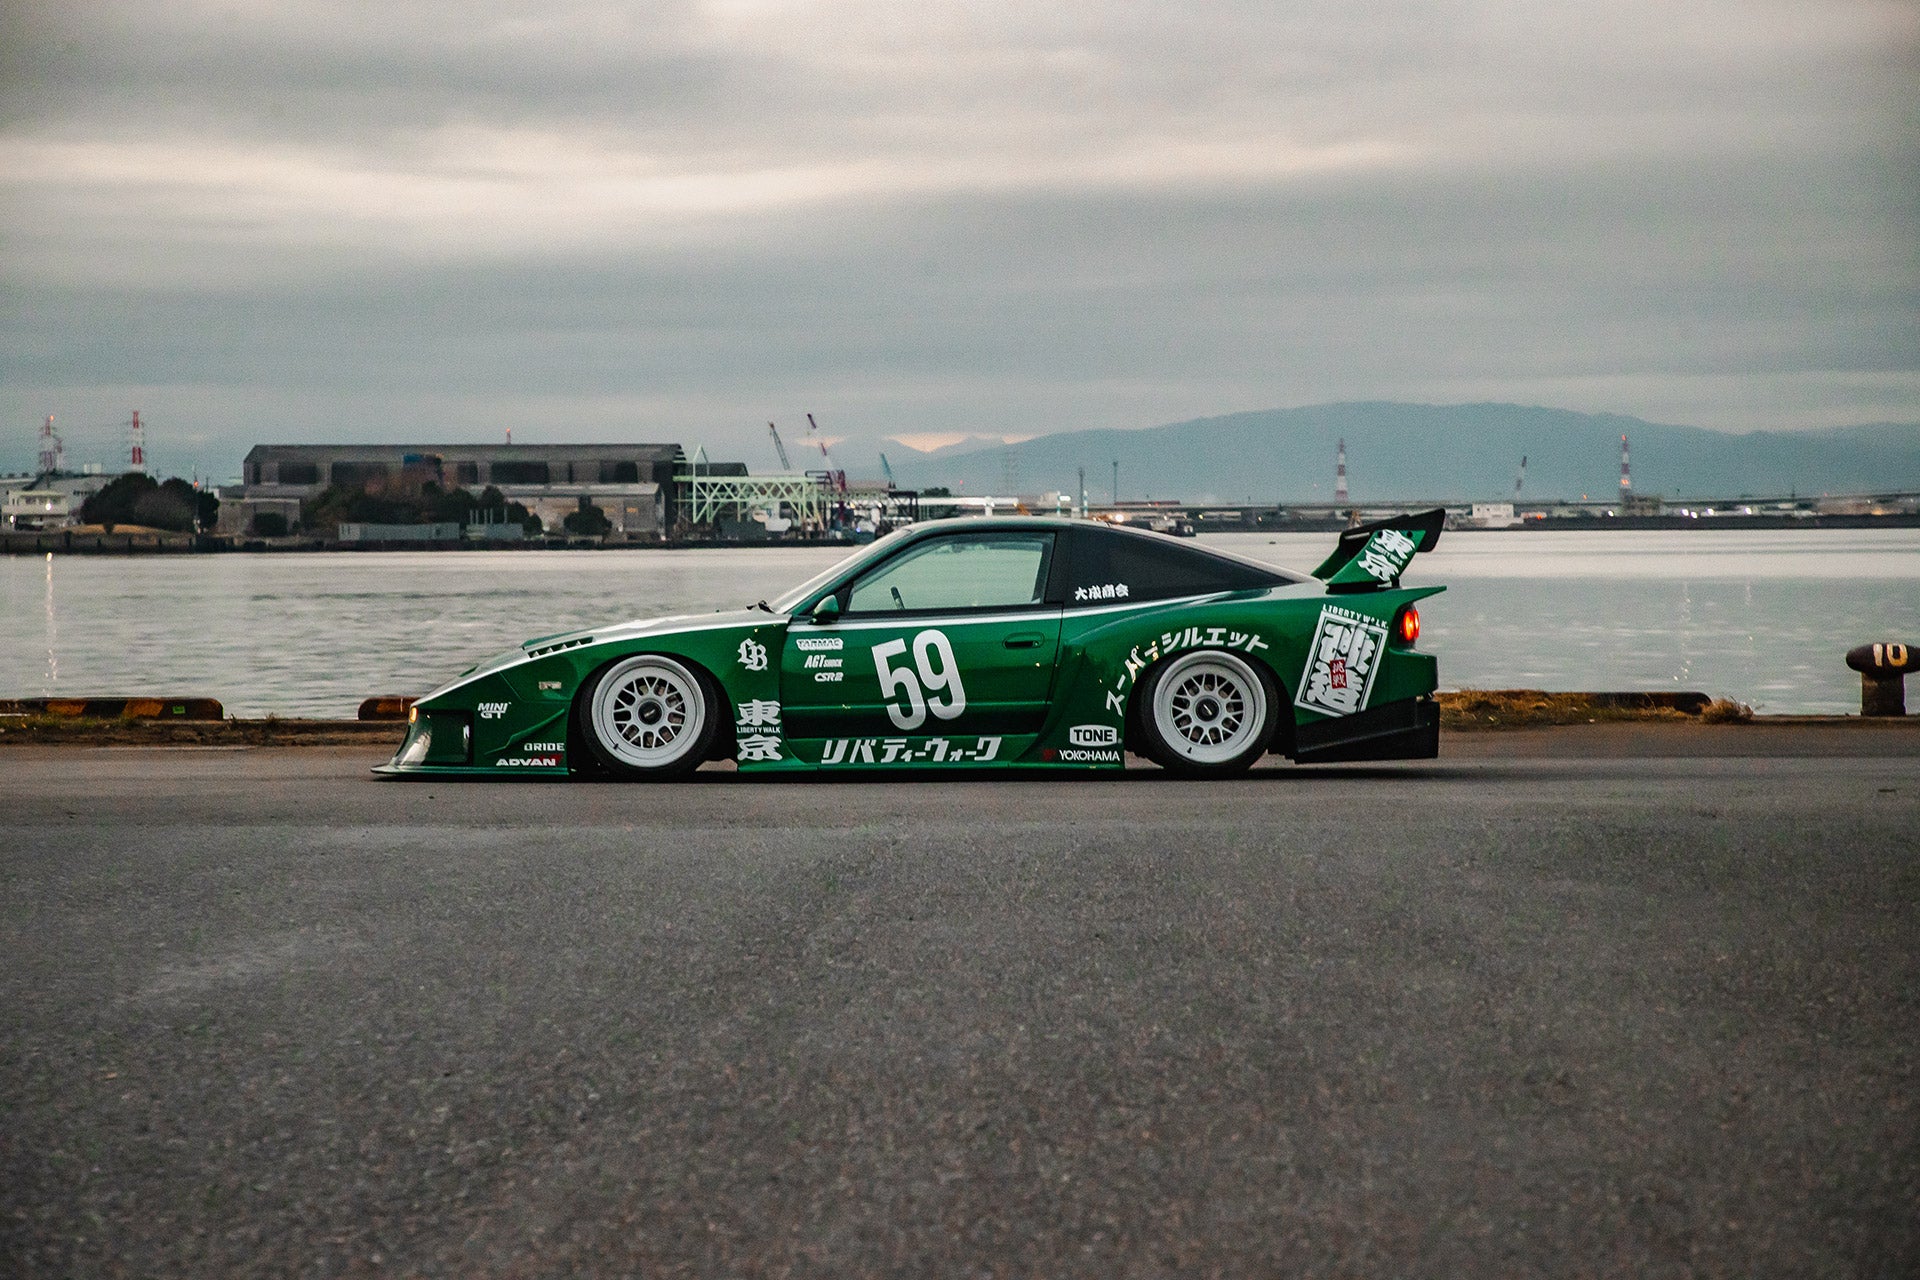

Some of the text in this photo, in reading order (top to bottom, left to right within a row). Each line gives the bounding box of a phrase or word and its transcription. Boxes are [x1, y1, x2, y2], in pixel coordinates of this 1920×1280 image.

[1322, 603, 1362, 620] LIBERTY
[1872, 643, 1908, 667] 10
[871, 629, 966, 730] 59
[1105, 627, 1269, 717] スーパーシルエット
[1073, 729, 1114, 742] TONE
[821, 736, 1002, 764] リバティーウォーク
[1058, 749, 1120, 761] YOKOHAMA
[495, 758, 556, 766] ADVAN
